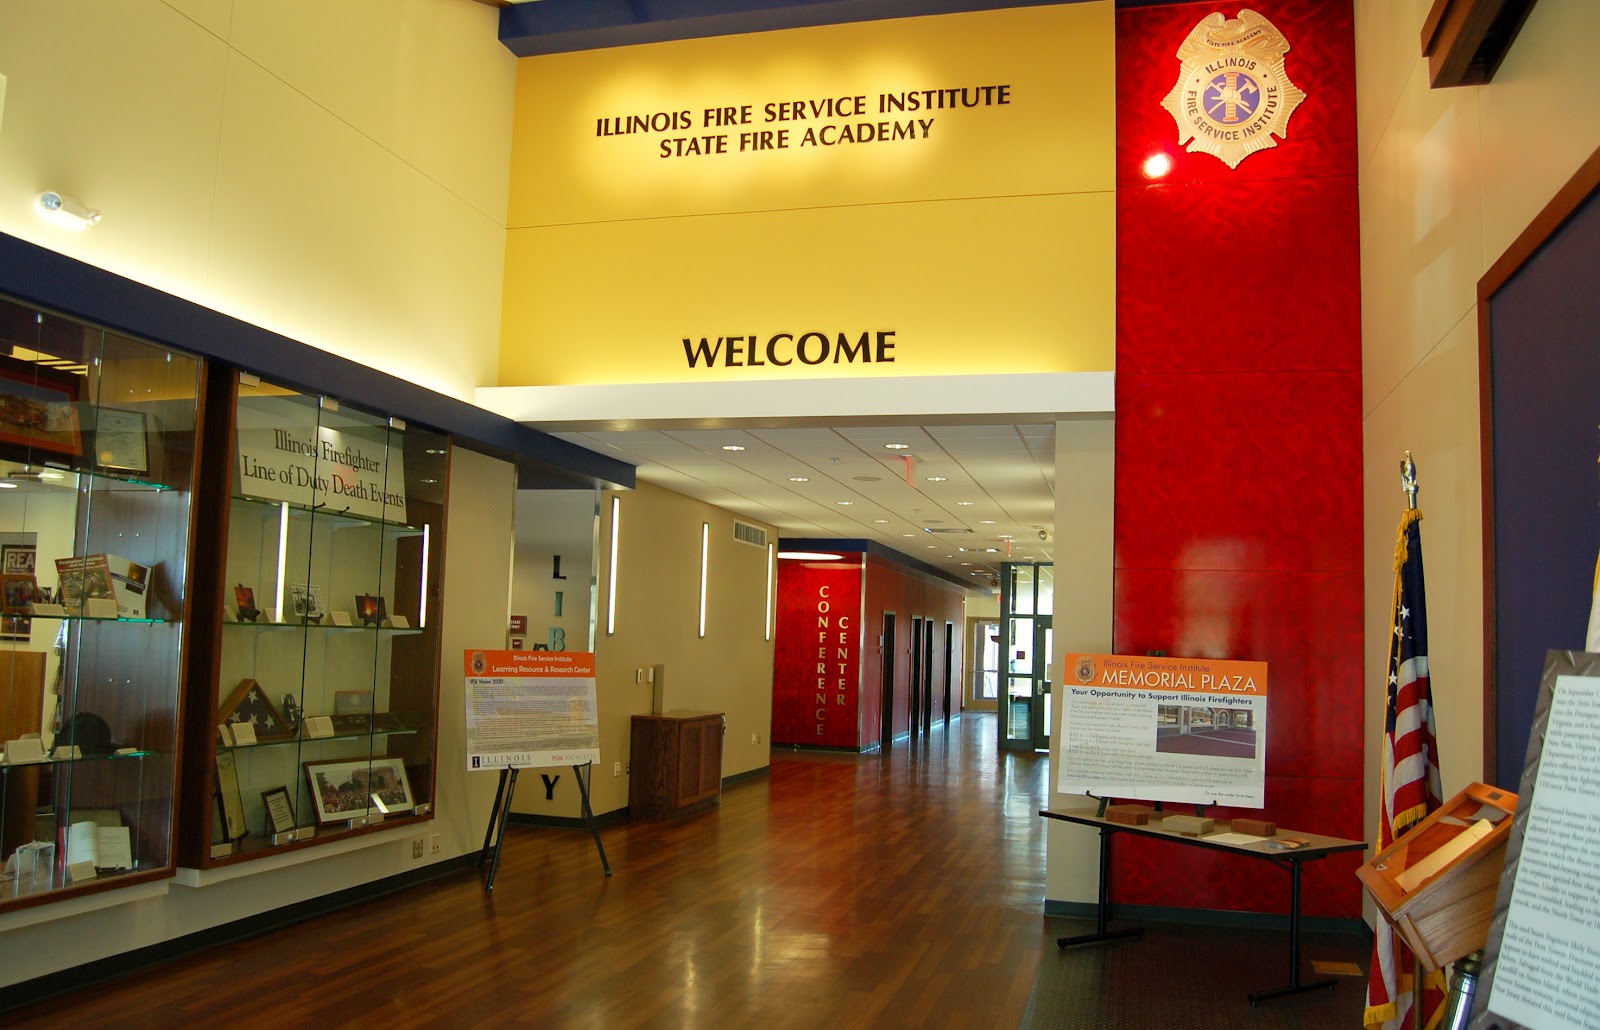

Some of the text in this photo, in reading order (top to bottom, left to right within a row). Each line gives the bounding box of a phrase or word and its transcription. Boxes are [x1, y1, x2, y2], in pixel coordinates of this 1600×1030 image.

[1206, 39, 1220, 47] STATE
[1236, 30, 1262, 44] ACADEMY
[1205, 57, 1256, 74] ILLINOIS
[596, 85, 1011, 136] ILLINOIS FIRE SERVICE INSTITUTE
[1187, 86, 1277, 140] FIRE SERVICE INSTITUTE
[660, 119, 934, 158] STATE FIRE ACADEMY
[682, 331, 896, 368] WELCOME
[273, 429, 380, 473] Illinois Firefighter
[242, 454, 404, 508] Line of Duty Death Events
[492, 665, 518, 674] Learning
[816, 586, 830, 735] CONFERENCE
[837, 617, 849, 705] CENTER
[1104, 660, 1210, 672] Illinois Fire Service Institute
[1090, 689, 1136, 700] Opportunity
[1148, 693, 1179, 701] Support
[1208, 696, 1252, 705] Firefighters
[1102, 670, 1257, 692] MEMORIAL PLAZA
[481, 755, 530, 763] ILLINOIS
